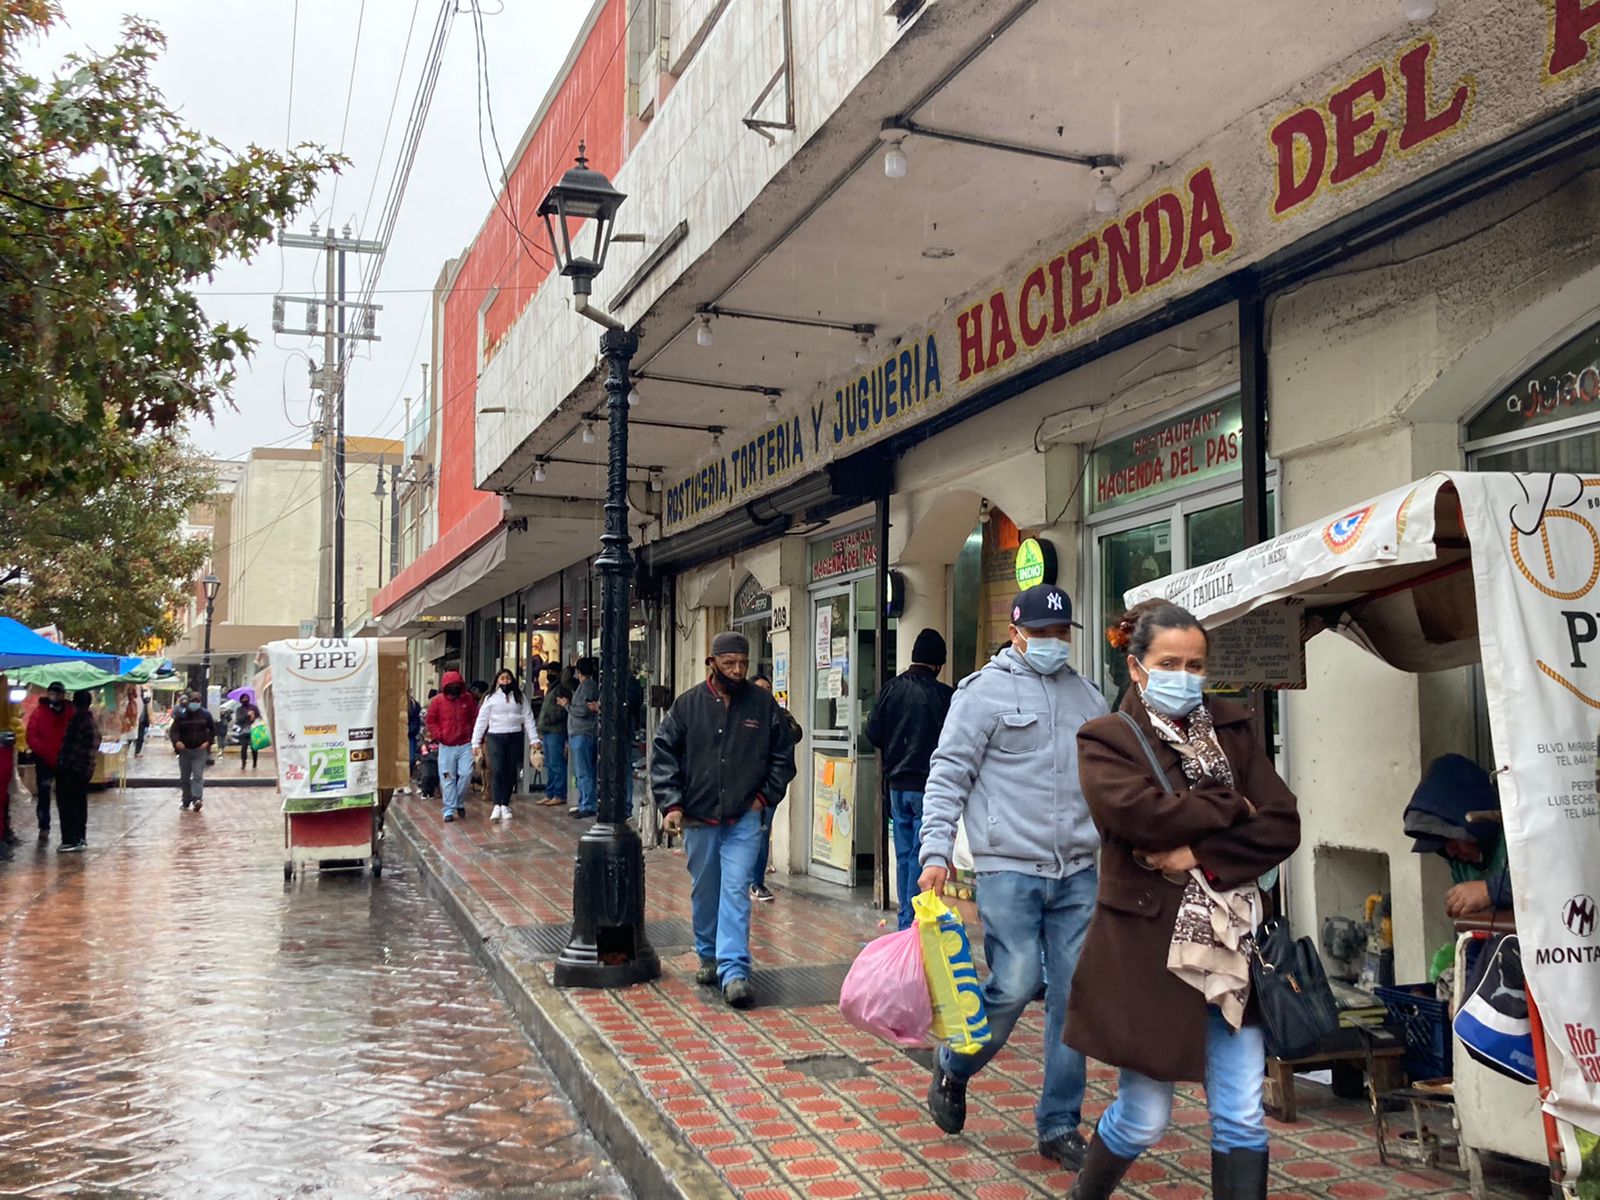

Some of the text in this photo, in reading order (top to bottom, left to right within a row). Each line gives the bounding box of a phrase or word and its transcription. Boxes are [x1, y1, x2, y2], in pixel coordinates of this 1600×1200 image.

[731, 415, 804, 490] TORTERIA
[811, 401, 824, 453] Y
[833, 333, 942, 445] JUGUERIA
[956, 167, 1233, 383] HACIENDA
[1270, 42, 1470, 215] DEL
[1098, 429, 1243, 504] HACIENDA DEL PAS
[812, 554, 846, 580] HACIENDA
[847, 549, 861, 571] DEL
[1019, 565, 1041, 581] INDIO
[1193, 573, 1234, 608] FAMILIA
[773, 606, 787, 629] 209
[1561, 610, 1600, 668] P
[298, 651, 357, 670] PEPE
[1537, 743, 1566, 754] BLVD.
[1556, 756, 1573, 766] TEL
[311, 753, 329, 785] 2
[1548, 796, 1571, 806] LUIS
[1564, 809, 1581, 819] TEL
[1564, 1022, 1597, 1056] Rio
